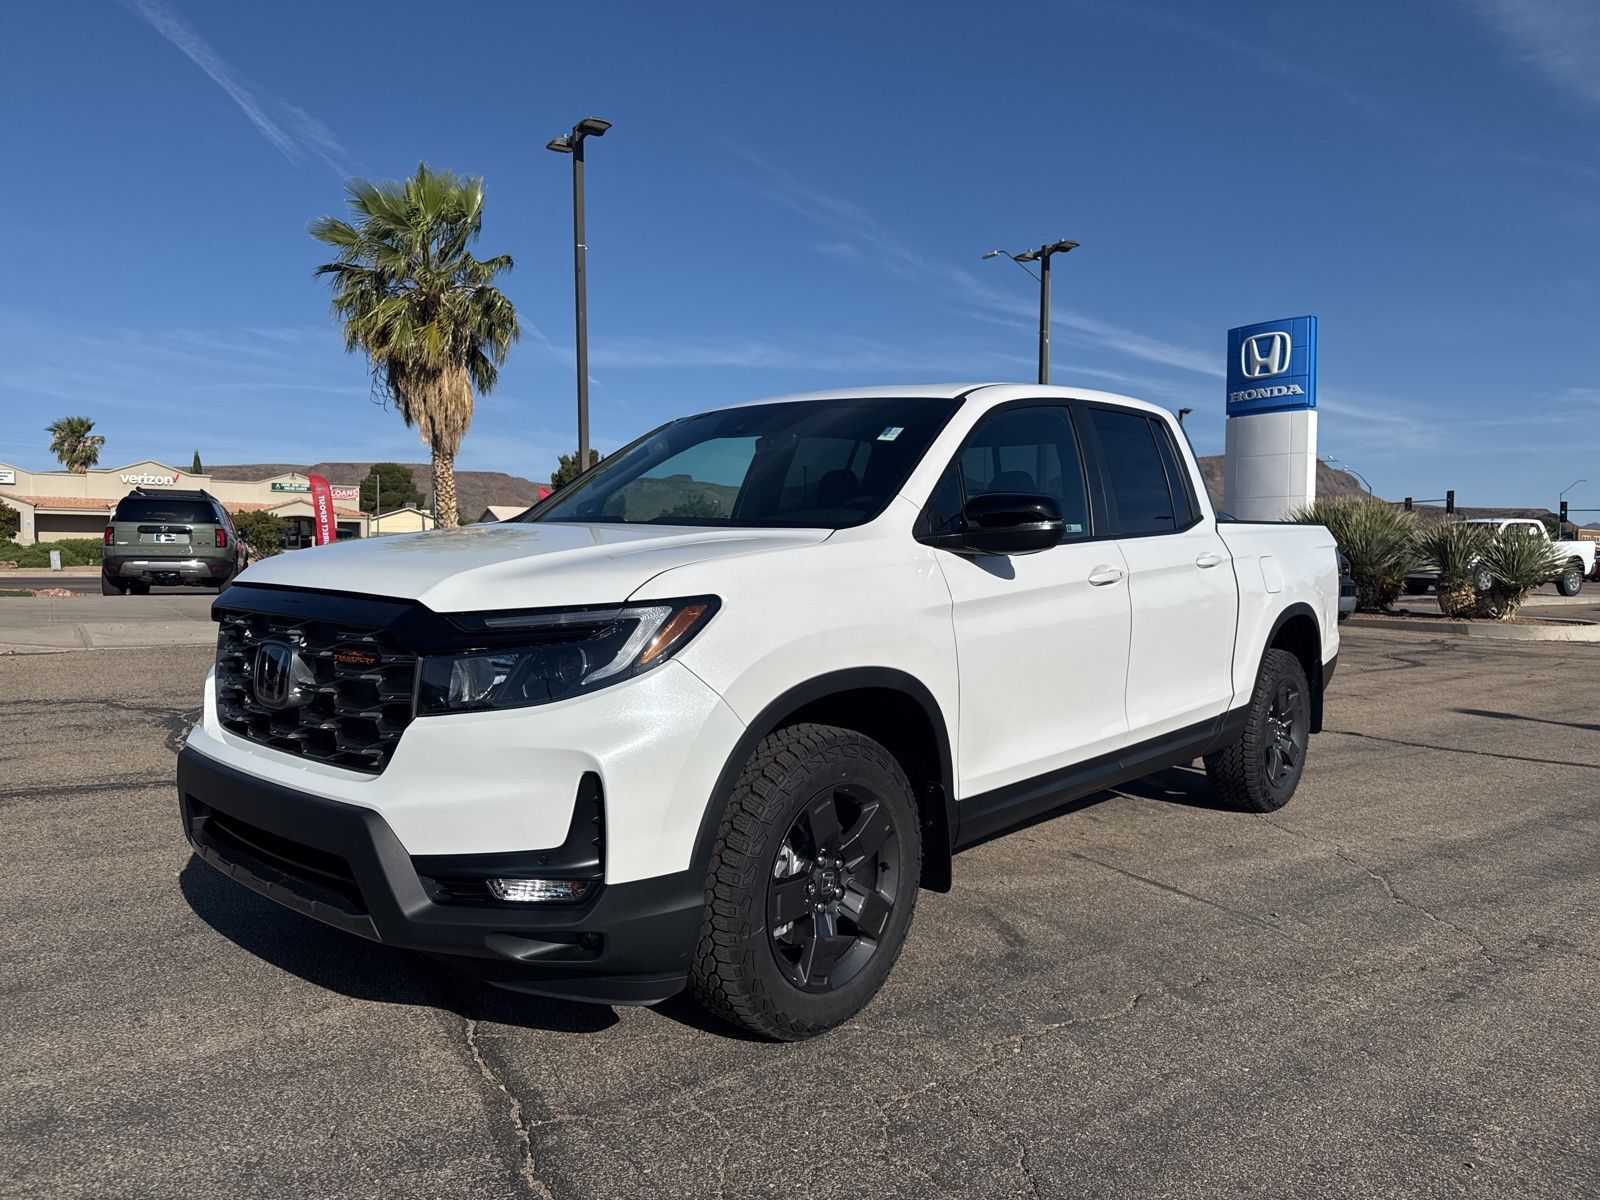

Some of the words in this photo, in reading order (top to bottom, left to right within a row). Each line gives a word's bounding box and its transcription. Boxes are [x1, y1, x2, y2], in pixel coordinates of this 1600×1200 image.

[1229, 384, 1305, 402] HONDA
[120, 473, 174, 485] verizon
[331, 489, 358, 498] LOANS
